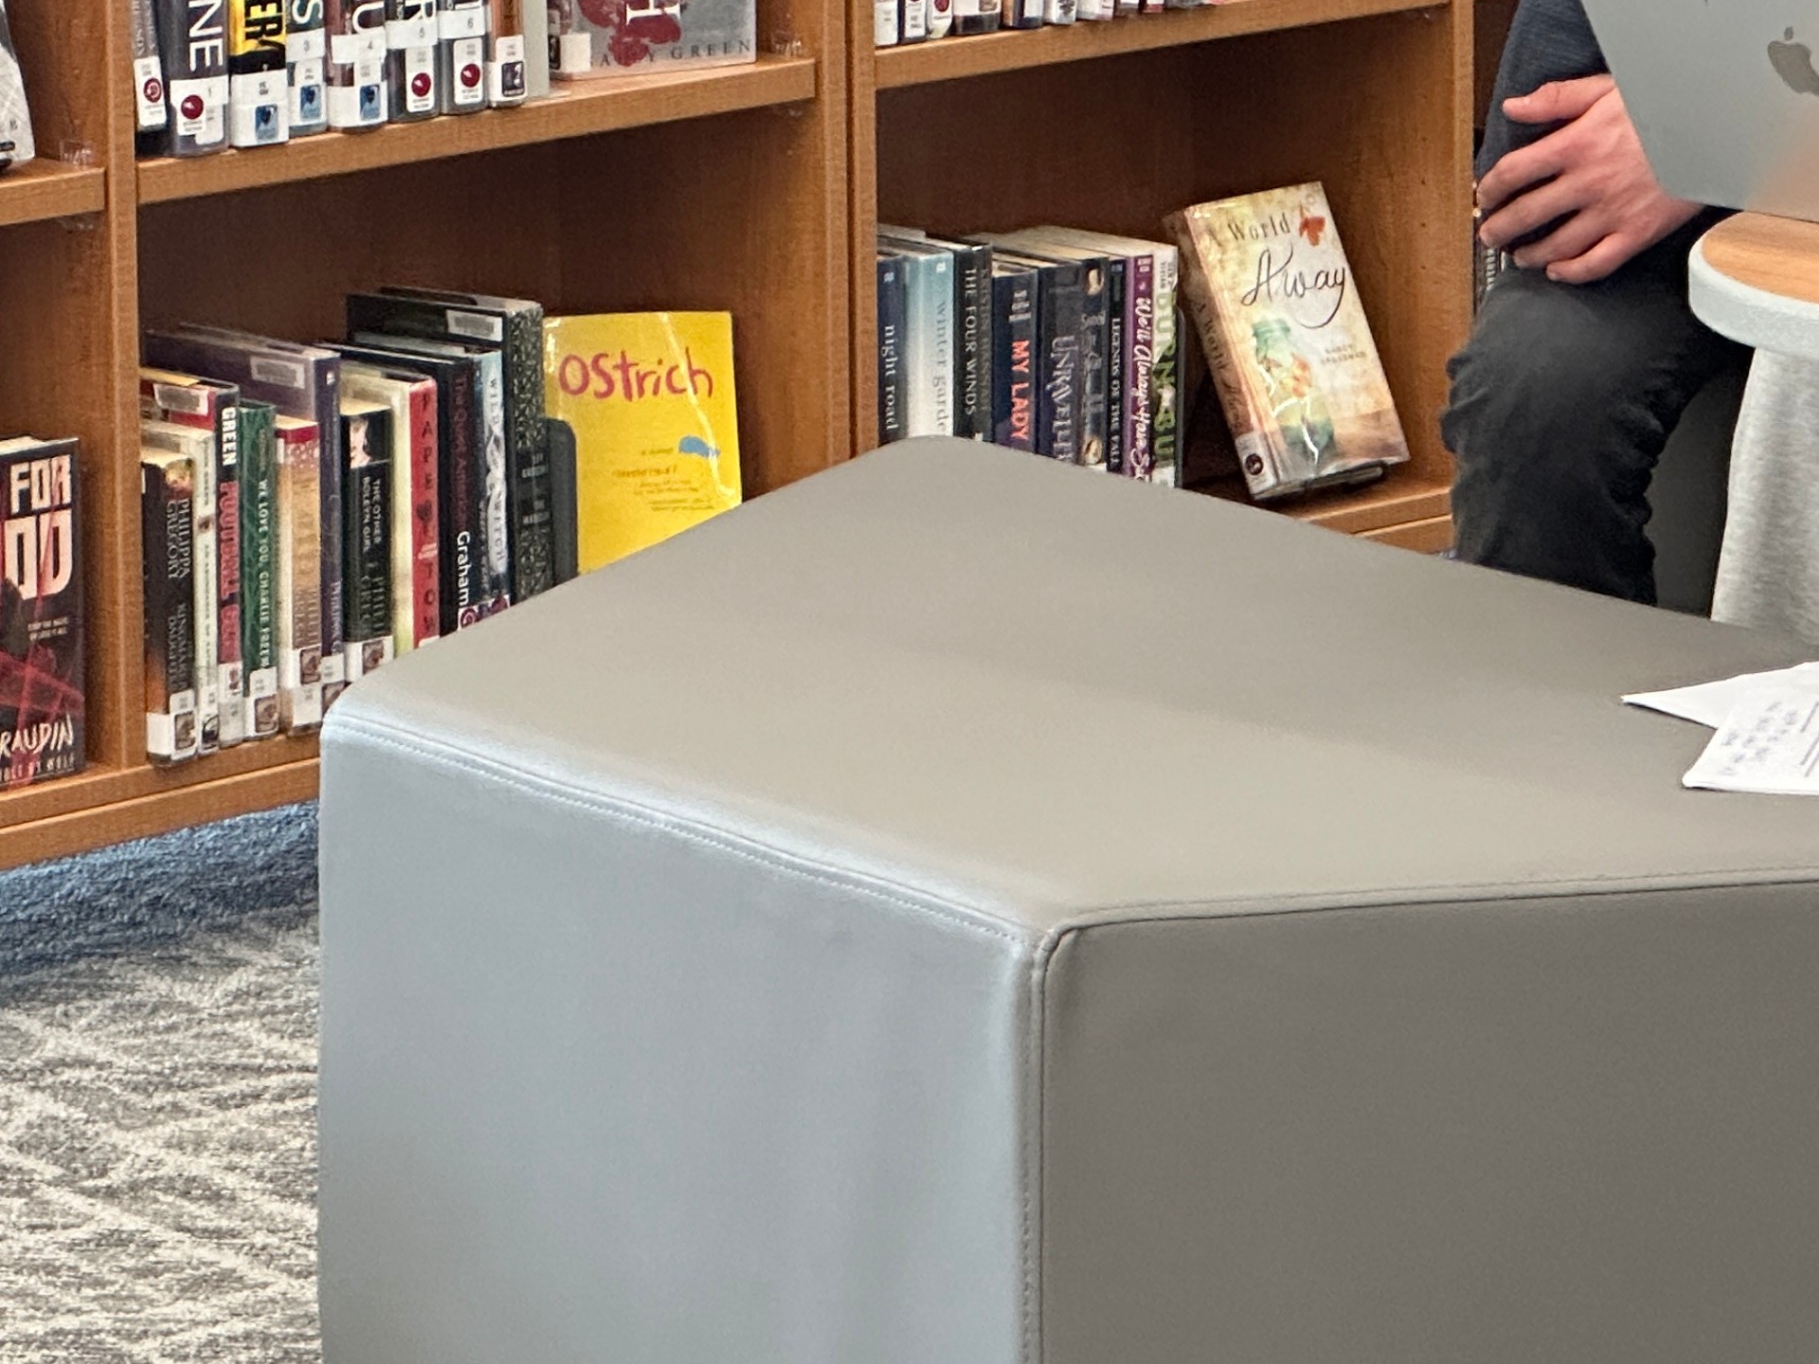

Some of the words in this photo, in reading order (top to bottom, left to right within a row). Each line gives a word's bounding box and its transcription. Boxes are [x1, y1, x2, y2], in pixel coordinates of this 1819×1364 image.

[670, 39, 752, 62] GREEN
[1228, 213, 1291, 242] World
[964, 268, 977, 297] THE
[979, 268, 991, 332] KRISTIN
[1241, 243, 1346, 329] Away
[936, 301, 950, 367] winter
[964, 305, 977, 352] FOUR
[1134, 296, 1152, 343] We'll
[1156, 291, 1178, 380] BURN
[882, 324, 898, 377] night
[1011, 339, 1031, 374] MY
[1111, 317, 1121, 375] LEGENDS
[964, 357, 977, 416] WINDS
[1110, 379, 1120, 399] OF
[1131, 345, 1152, 405] Always
[489, 378, 501, 425] WILD
[886, 384, 898, 431] road
[1010, 383, 1030, 441] LADY
[1110, 403, 1120, 429] THE
[221, 407, 237, 466] GREEN
[452, 408, 468, 453] Quiet
[1132, 407, 1150, 447] Have
[1110, 435, 1120, 467] FALL
[11, 454, 71, 514] FOR
[258, 479, 269, 498] WE
[363, 476, 371, 523] BOLEYN
[372, 478, 380, 500] THE
[167, 501, 179, 579] GREGORY
[179, 498, 191, 579] PHILIPPA
[258, 502, 270, 533] LOVE
[363, 526, 372, 553] GIRL
[371, 504, 380, 545] OTHER
[456, 530, 471, 606] Graham
[259, 571, 271, 624] CHARLIE
